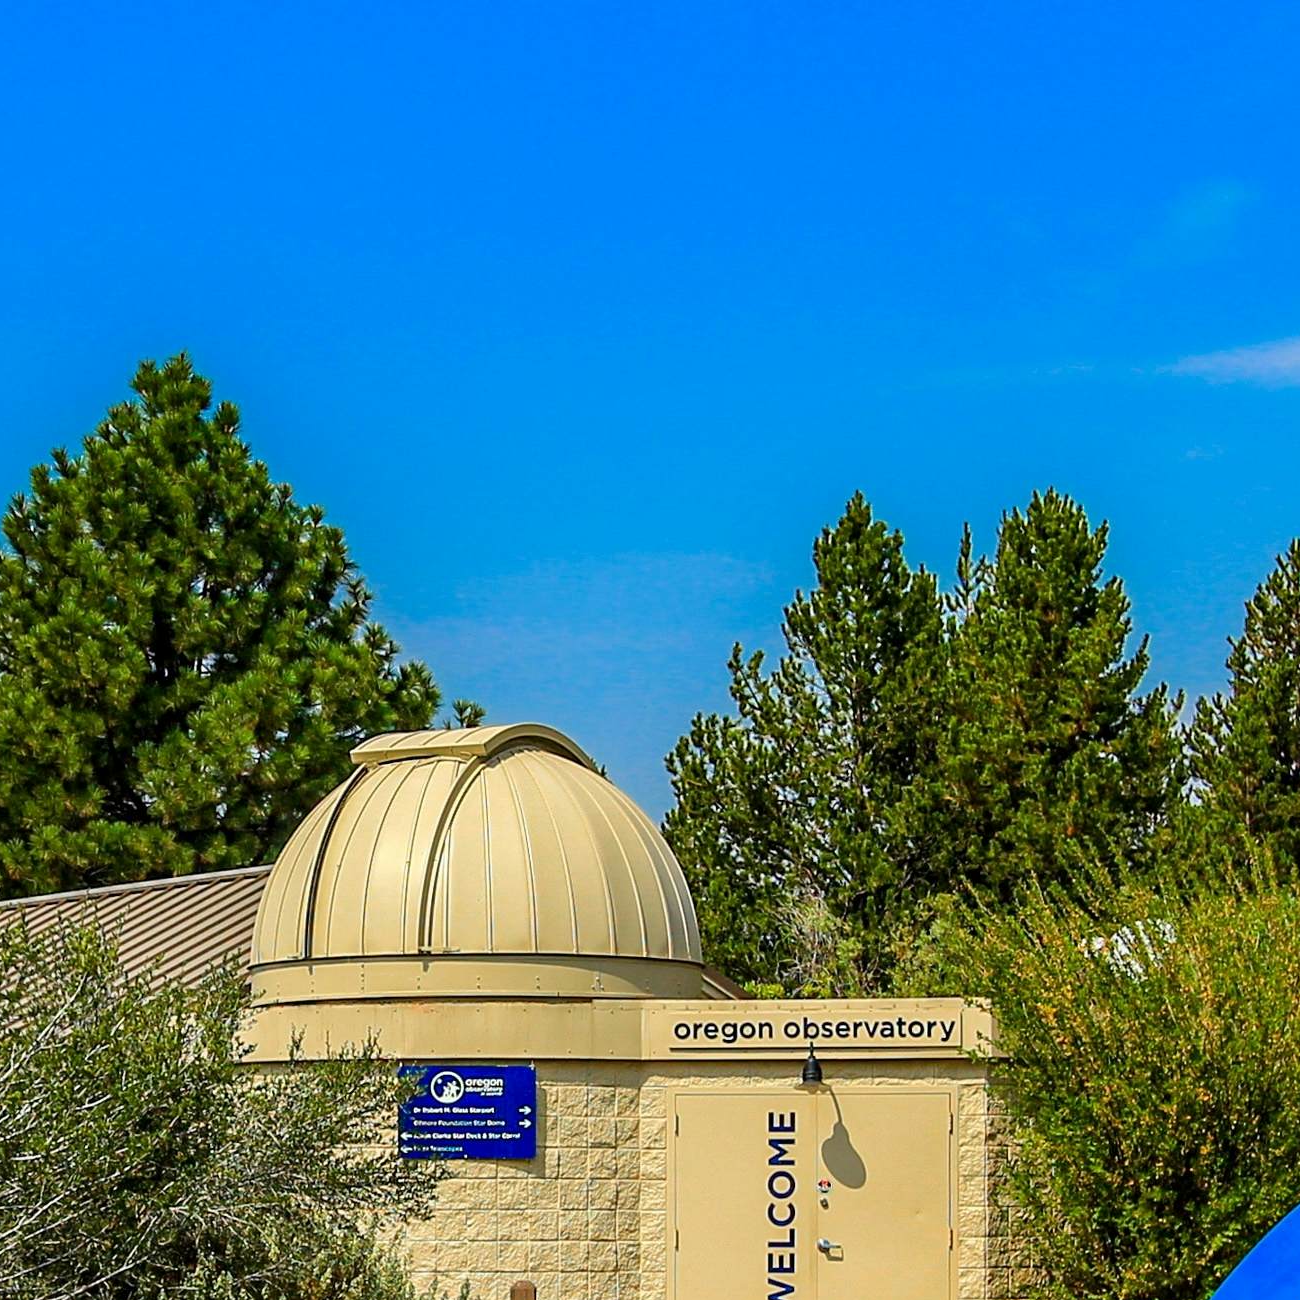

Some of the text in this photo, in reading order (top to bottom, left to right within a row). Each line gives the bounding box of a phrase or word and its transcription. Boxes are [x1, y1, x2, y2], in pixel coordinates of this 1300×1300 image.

[674, 1017, 956, 1043] oregon observatory
[465, 1078, 503, 1089] oregon
